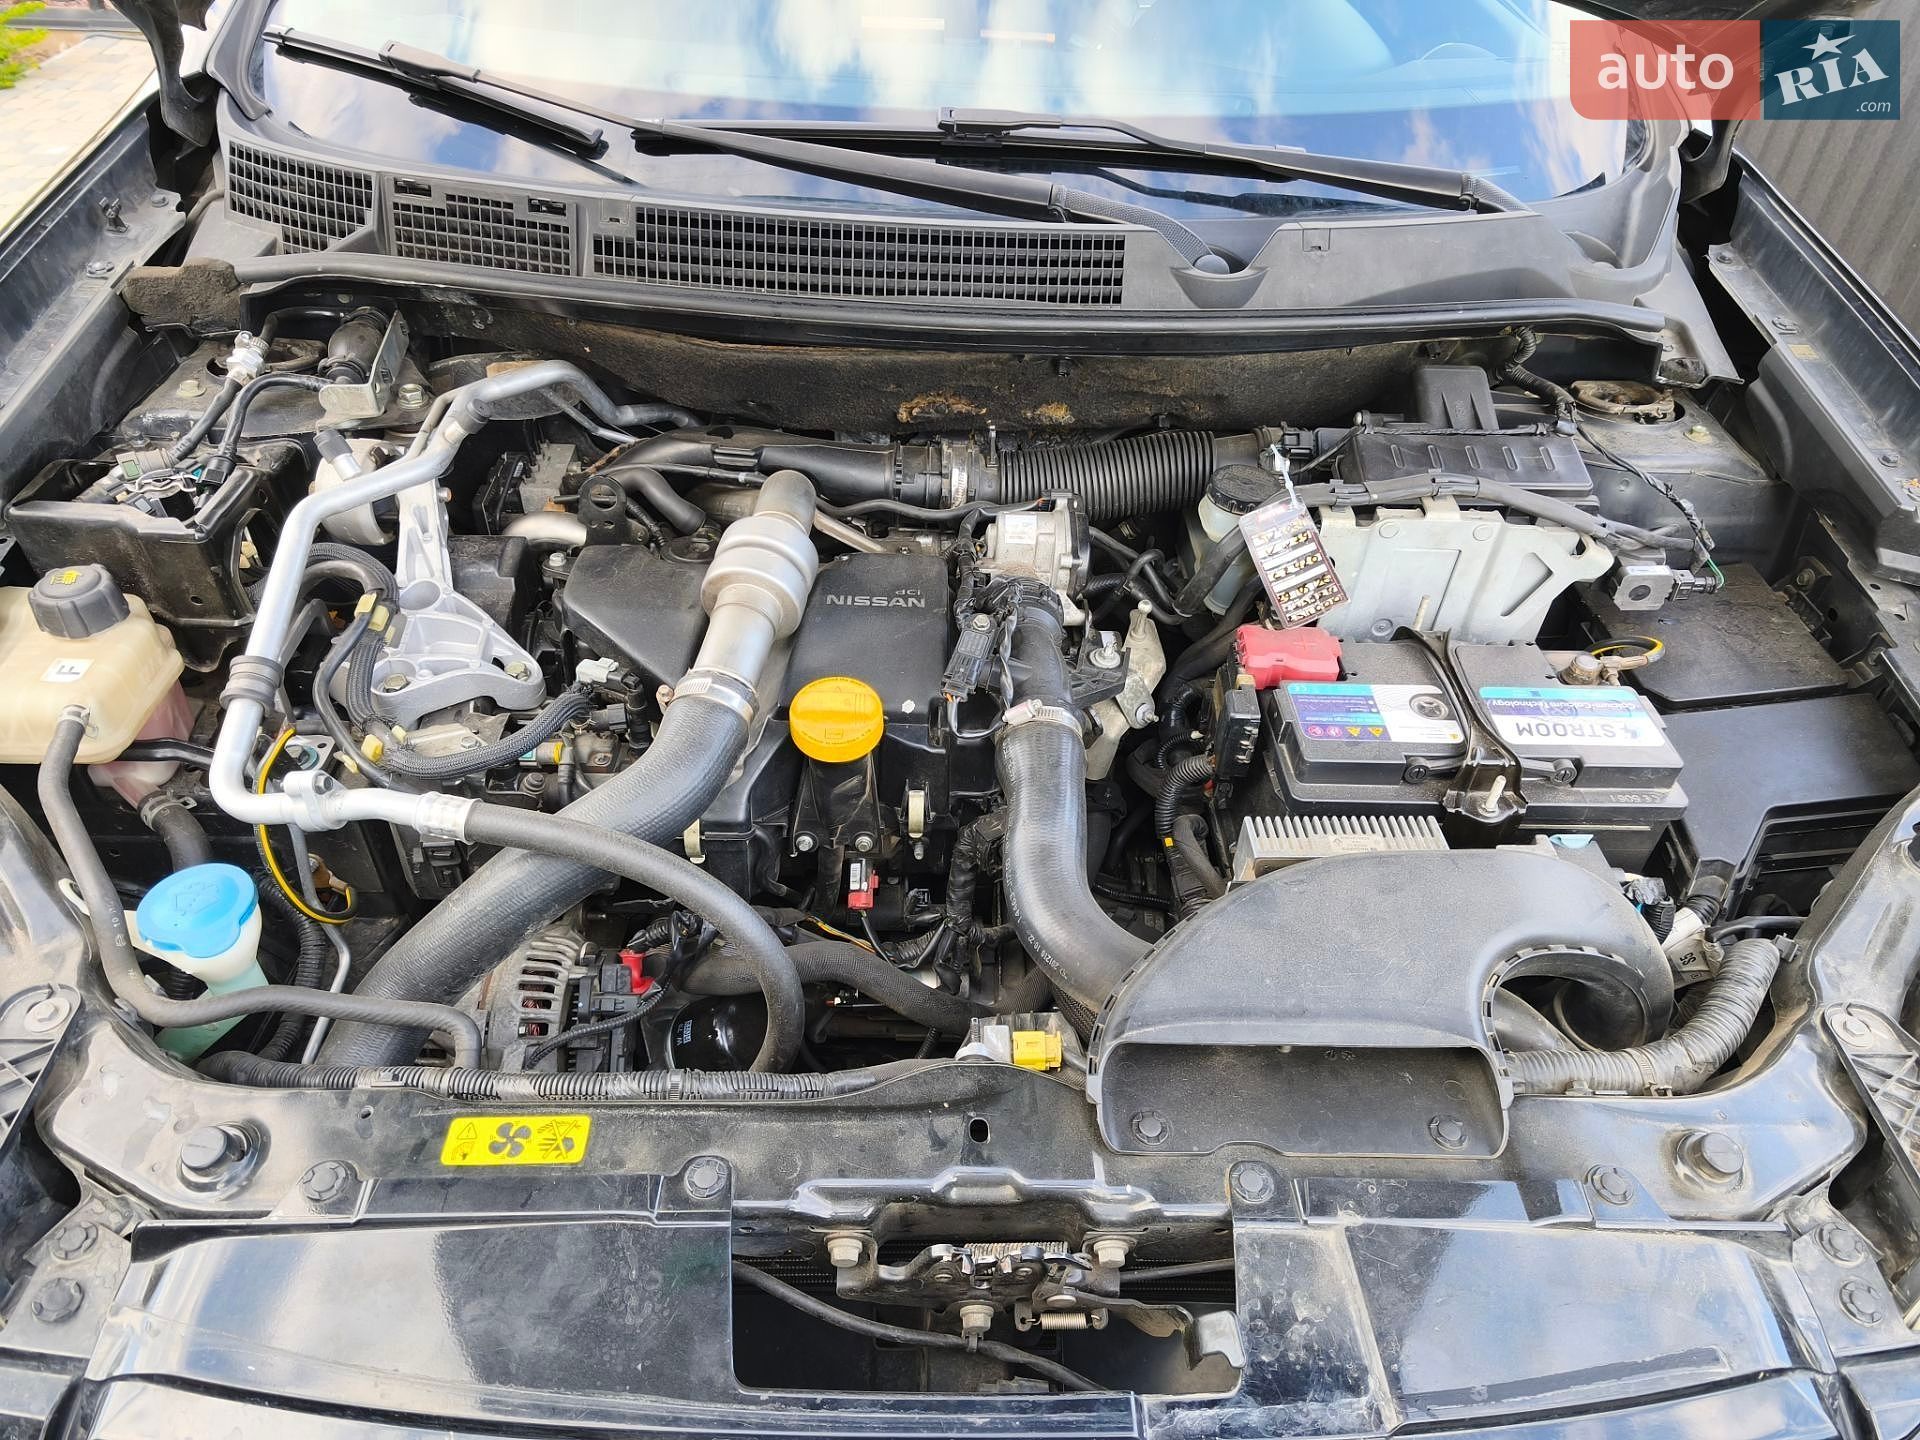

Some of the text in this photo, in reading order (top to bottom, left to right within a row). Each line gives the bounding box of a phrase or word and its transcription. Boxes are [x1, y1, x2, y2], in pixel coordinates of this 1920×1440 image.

[826, 594, 926, 608] NISSAN
[1515, 721, 1617, 738] STROOM
[1679, 952, 1697, 965] S5
